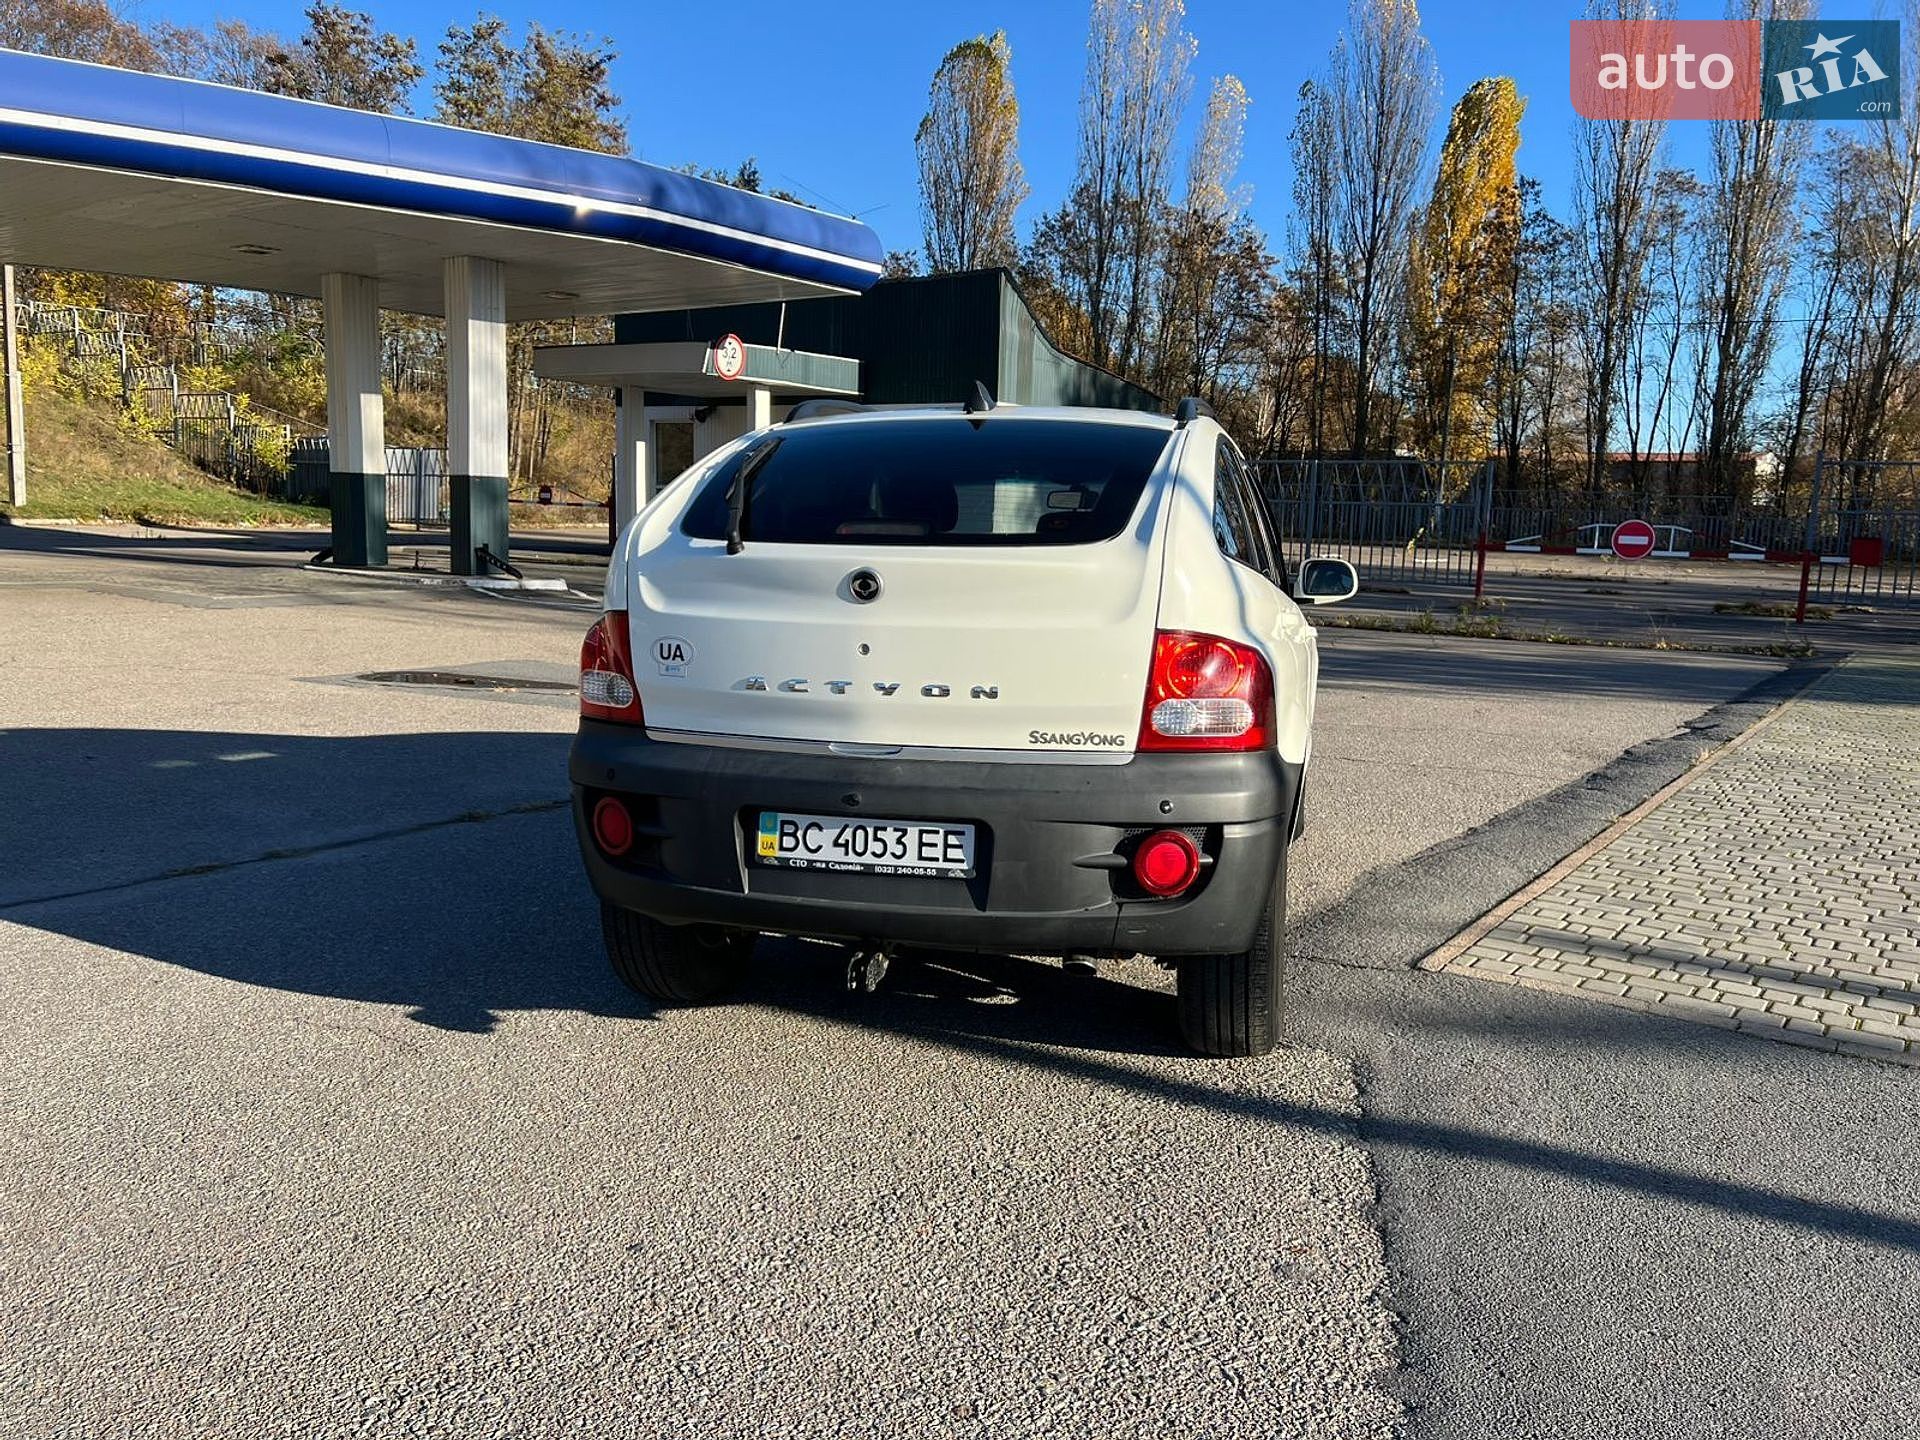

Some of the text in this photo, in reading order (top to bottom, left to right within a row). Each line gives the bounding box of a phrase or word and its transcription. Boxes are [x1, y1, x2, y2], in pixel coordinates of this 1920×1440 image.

[660, 643, 685, 661] UA
[744, 676, 999, 700] ACTYON
[761, 841, 775, 851] UA
[779, 819, 967, 864] BC 4053 EE
